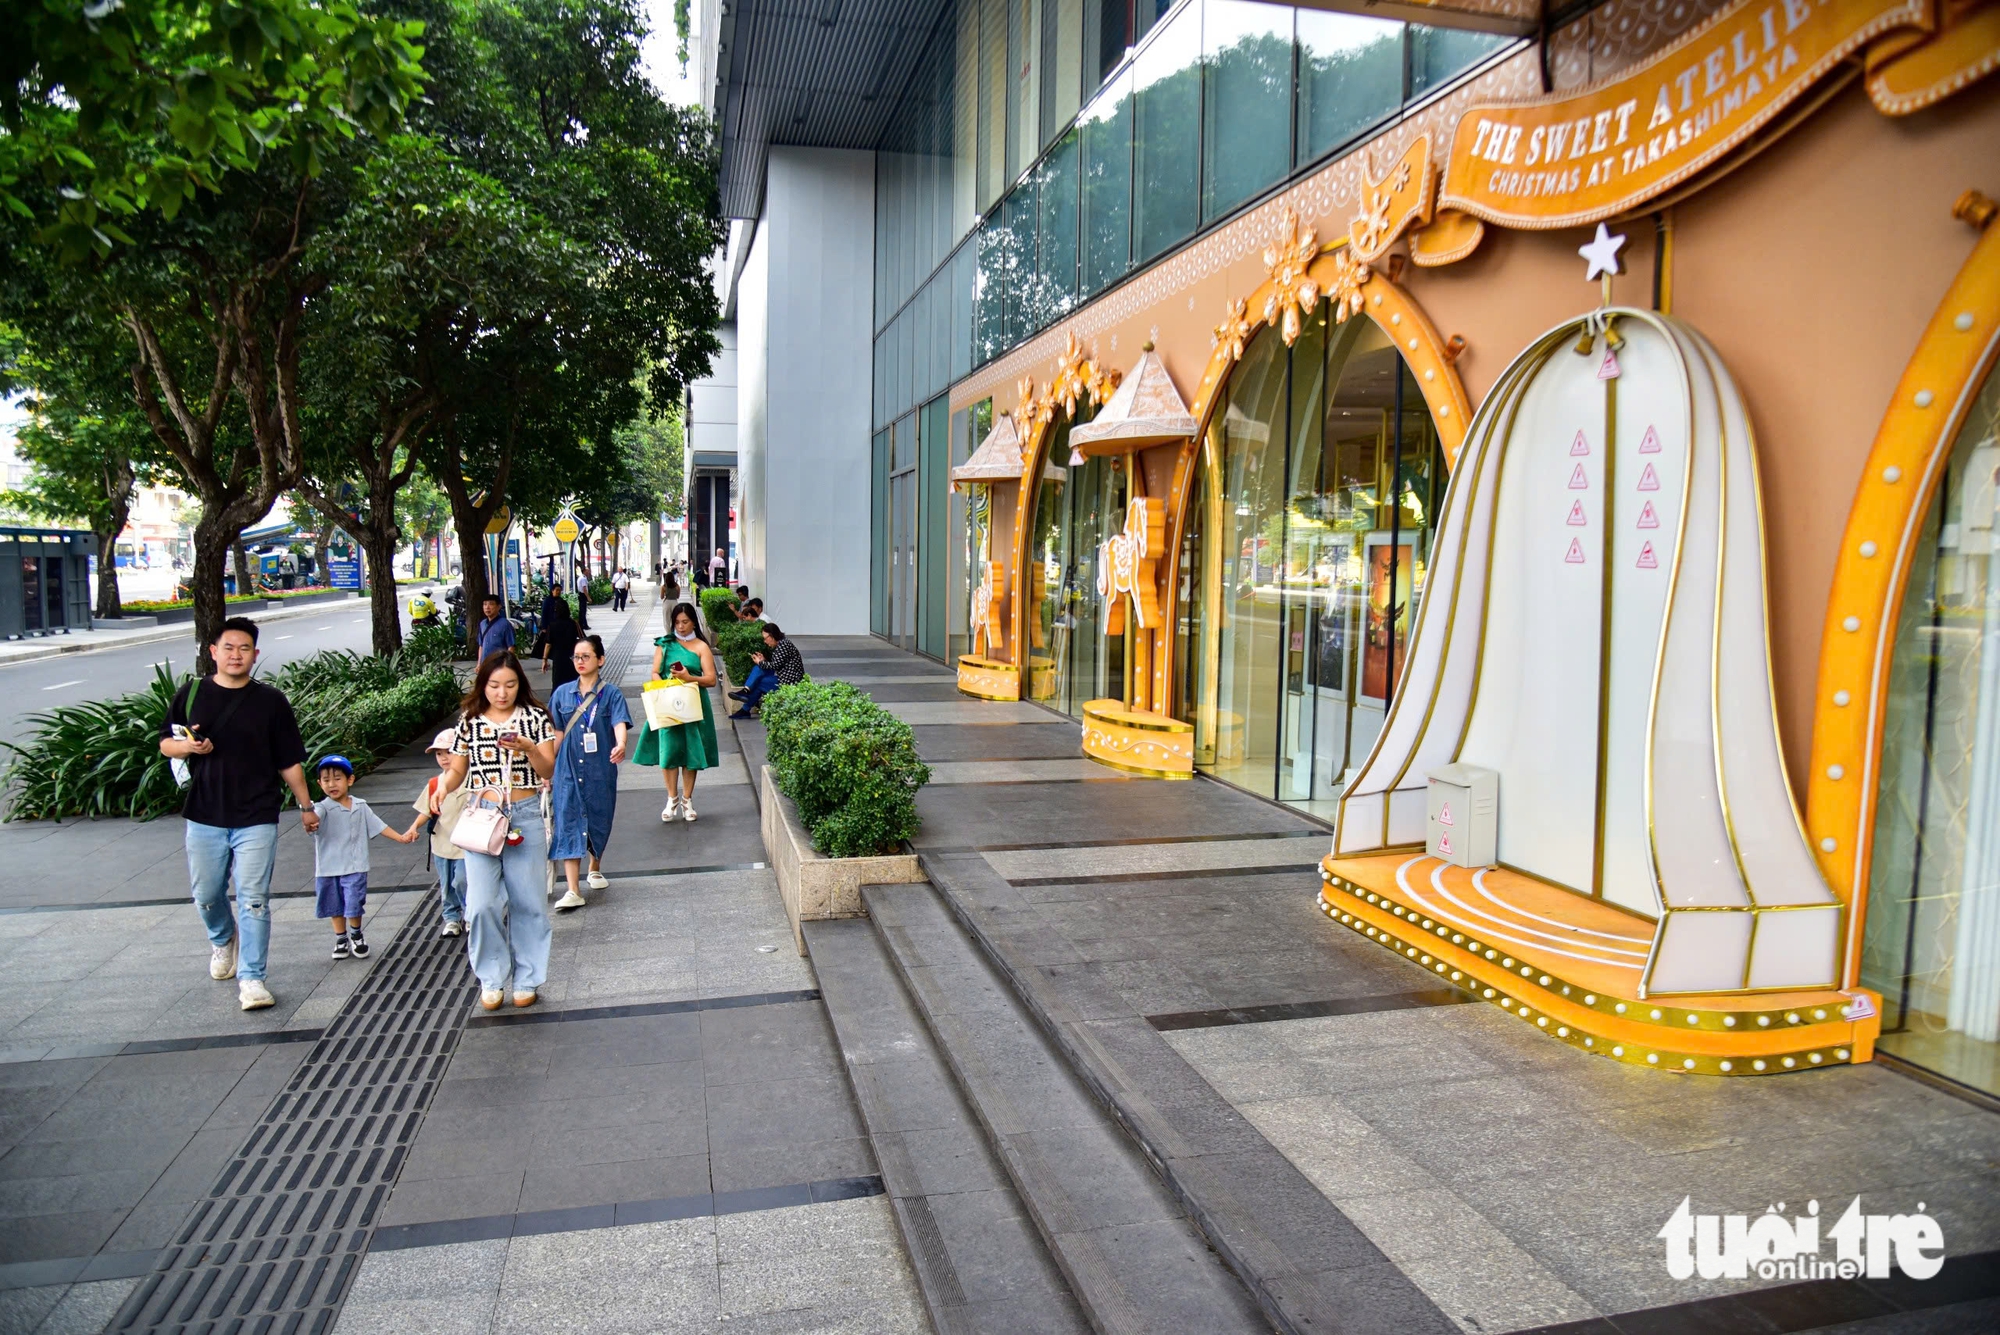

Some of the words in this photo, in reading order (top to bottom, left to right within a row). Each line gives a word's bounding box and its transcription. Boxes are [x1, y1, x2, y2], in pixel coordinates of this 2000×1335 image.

[1470, 118, 1523, 165] THE
[1524, 98, 1638, 166] SWEET
[1647, 0, 1827, 131] ATELIE
[1488, 166, 1581, 198] CHRISTMAS
[1586, 156, 1615, 188] AT
[1622, 44, 1799, 175] TAKASHIMAYA
